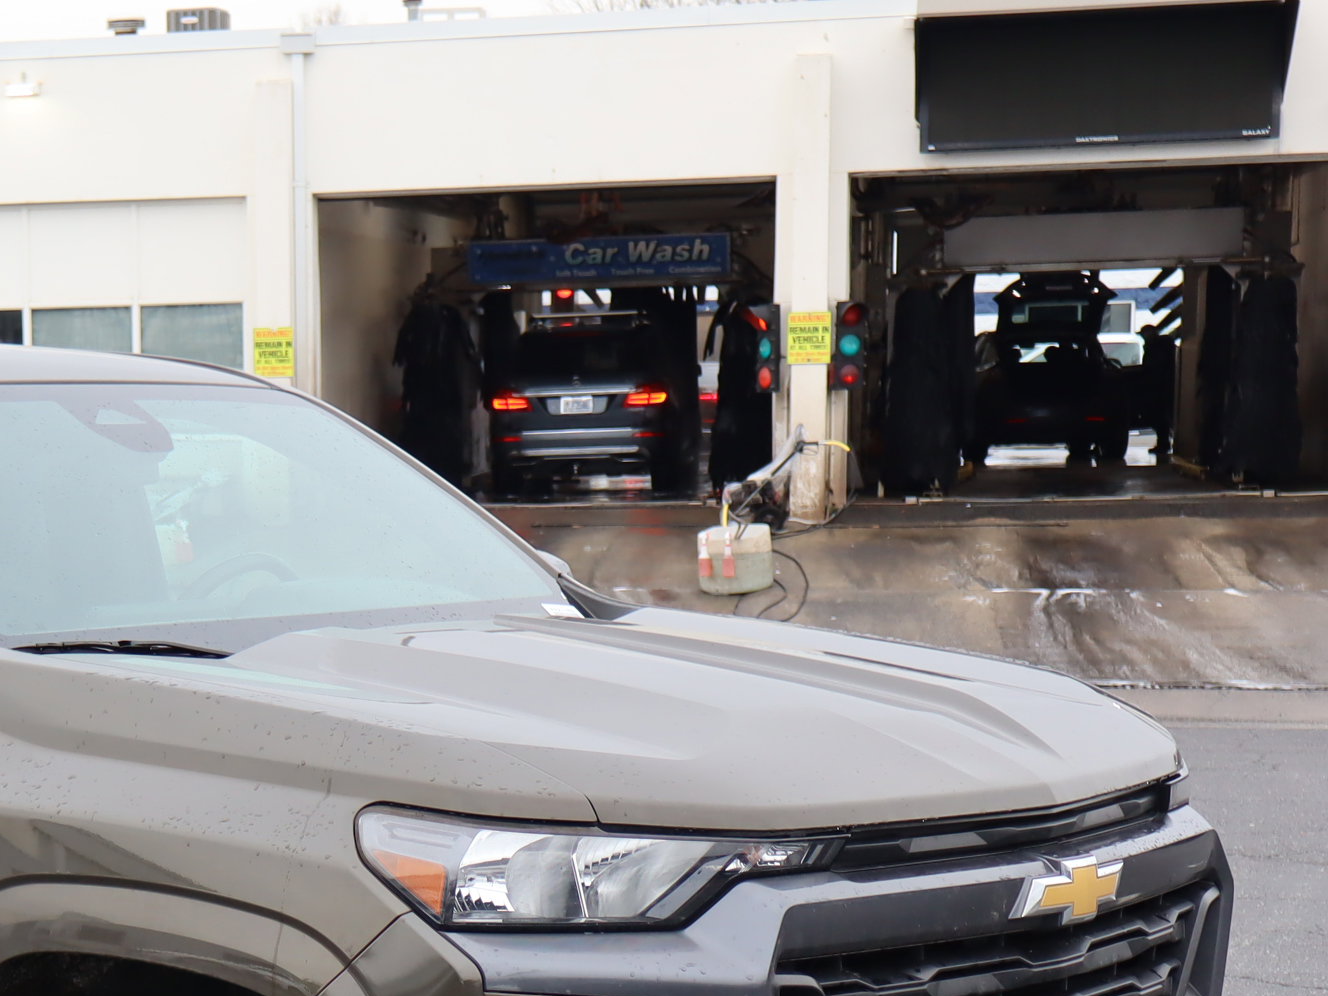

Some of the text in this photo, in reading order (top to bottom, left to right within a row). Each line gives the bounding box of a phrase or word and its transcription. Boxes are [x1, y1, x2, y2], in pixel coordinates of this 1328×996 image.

[565, 239, 710, 265] Car Wash
[789, 326, 830, 335] REMAIN IN
[792, 335, 825, 345] VEHICLE
[255, 341, 282, 349] REMAIN
[258, 350, 289, 359] VEHICLE
